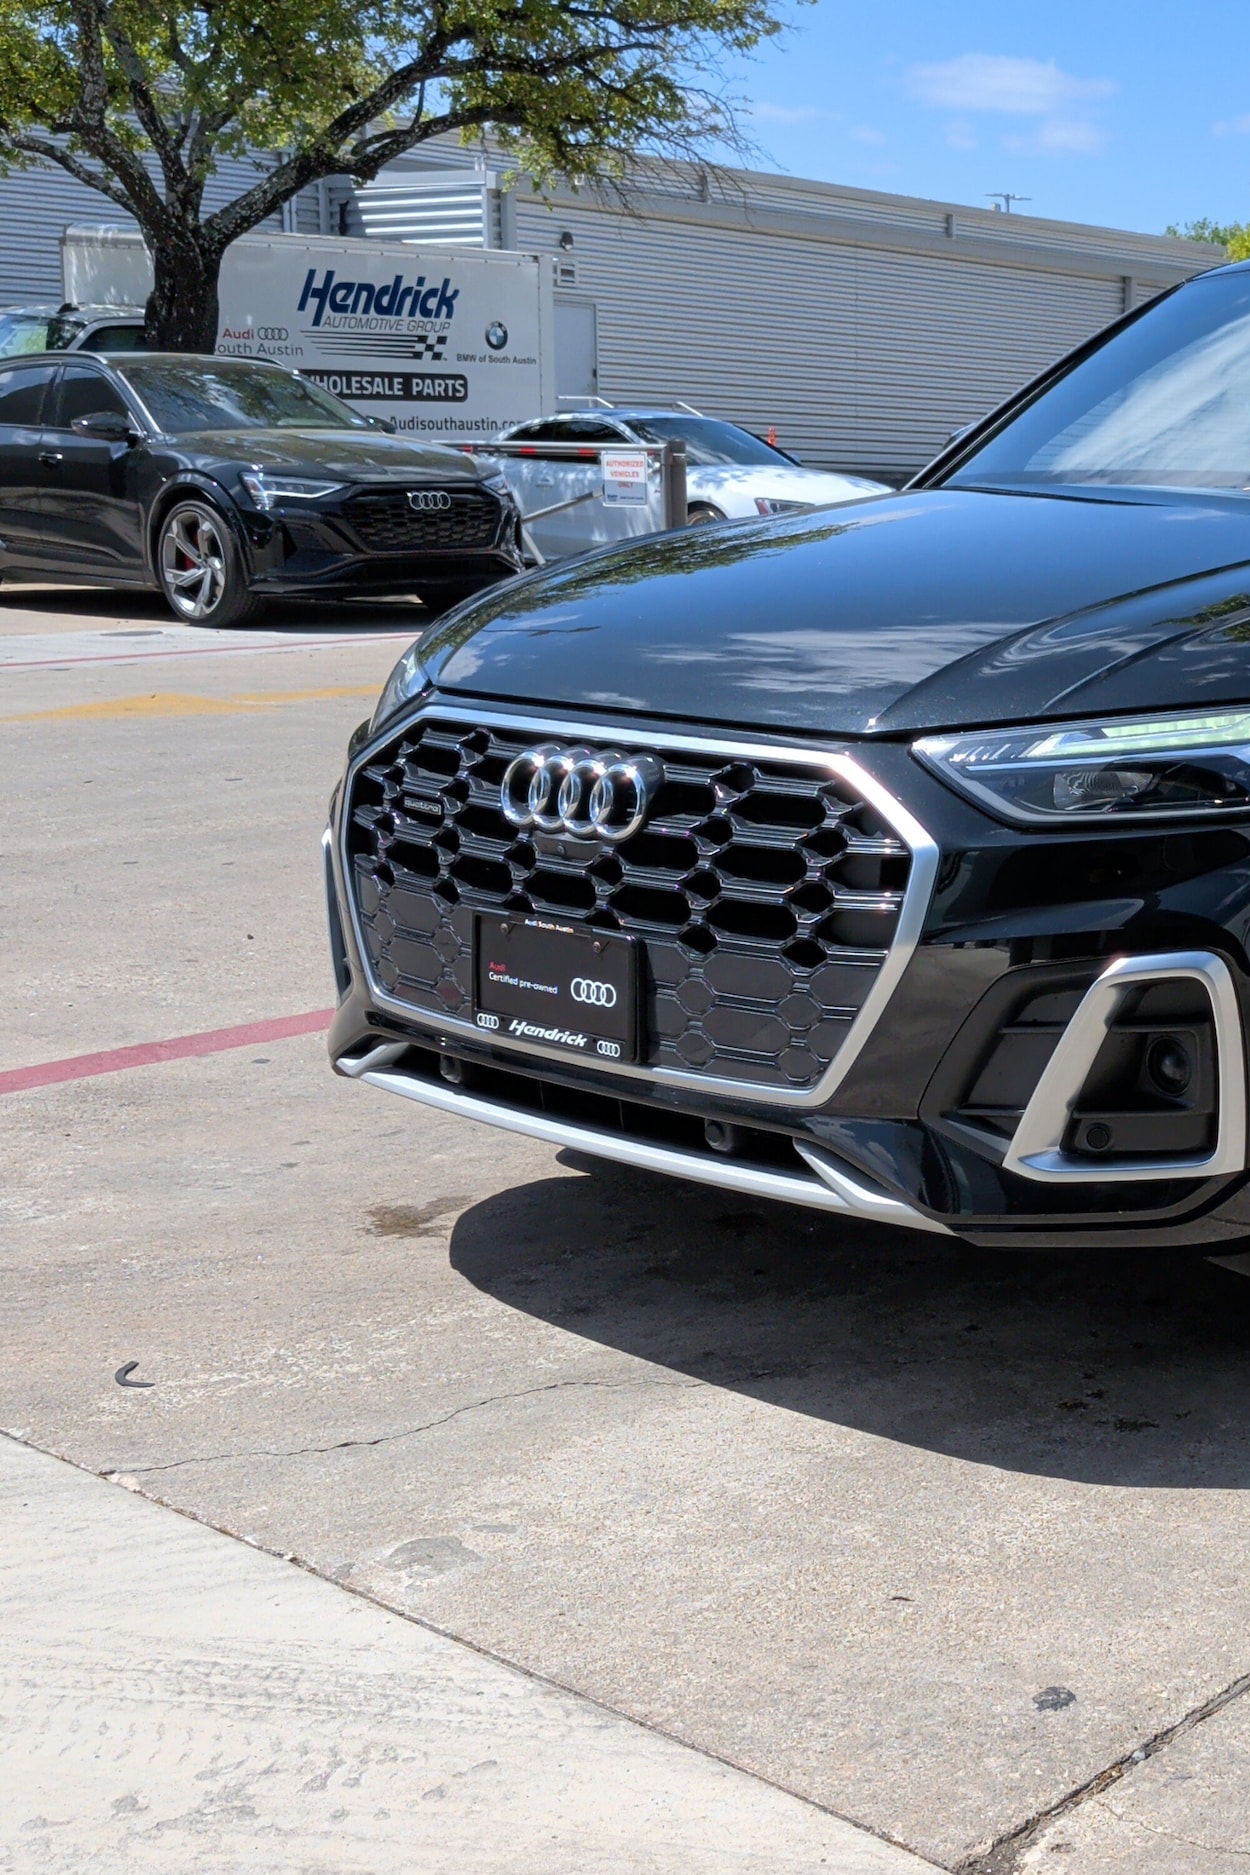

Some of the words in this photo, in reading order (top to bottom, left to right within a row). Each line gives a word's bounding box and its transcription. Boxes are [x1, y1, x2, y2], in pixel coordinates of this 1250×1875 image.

[297, 269, 459, 327] Hendrick
[322, 315, 404, 332] AUTOMOTIVE
[407, 319, 451, 333] GROUP
[222, 328, 255, 340] Audi
[216, 343, 252, 354] outh
[257, 343, 304, 356] Austin
[456, 353, 477, 362] BMW
[479, 353, 487, 363] of
[488, 355, 511, 364] South
[513, 355, 537, 365] Austin
[412, 378, 465, 397] PARTS
[390, 415, 525, 431] Audisouthaustin.co
[525, 919, 538, 927] Audi
[489, 961, 506, 972] Audi
[489, 972, 518, 986] Certified
[519, 980, 558, 995] pre-owned
[508, 1019, 587, 1048] Hendrick
